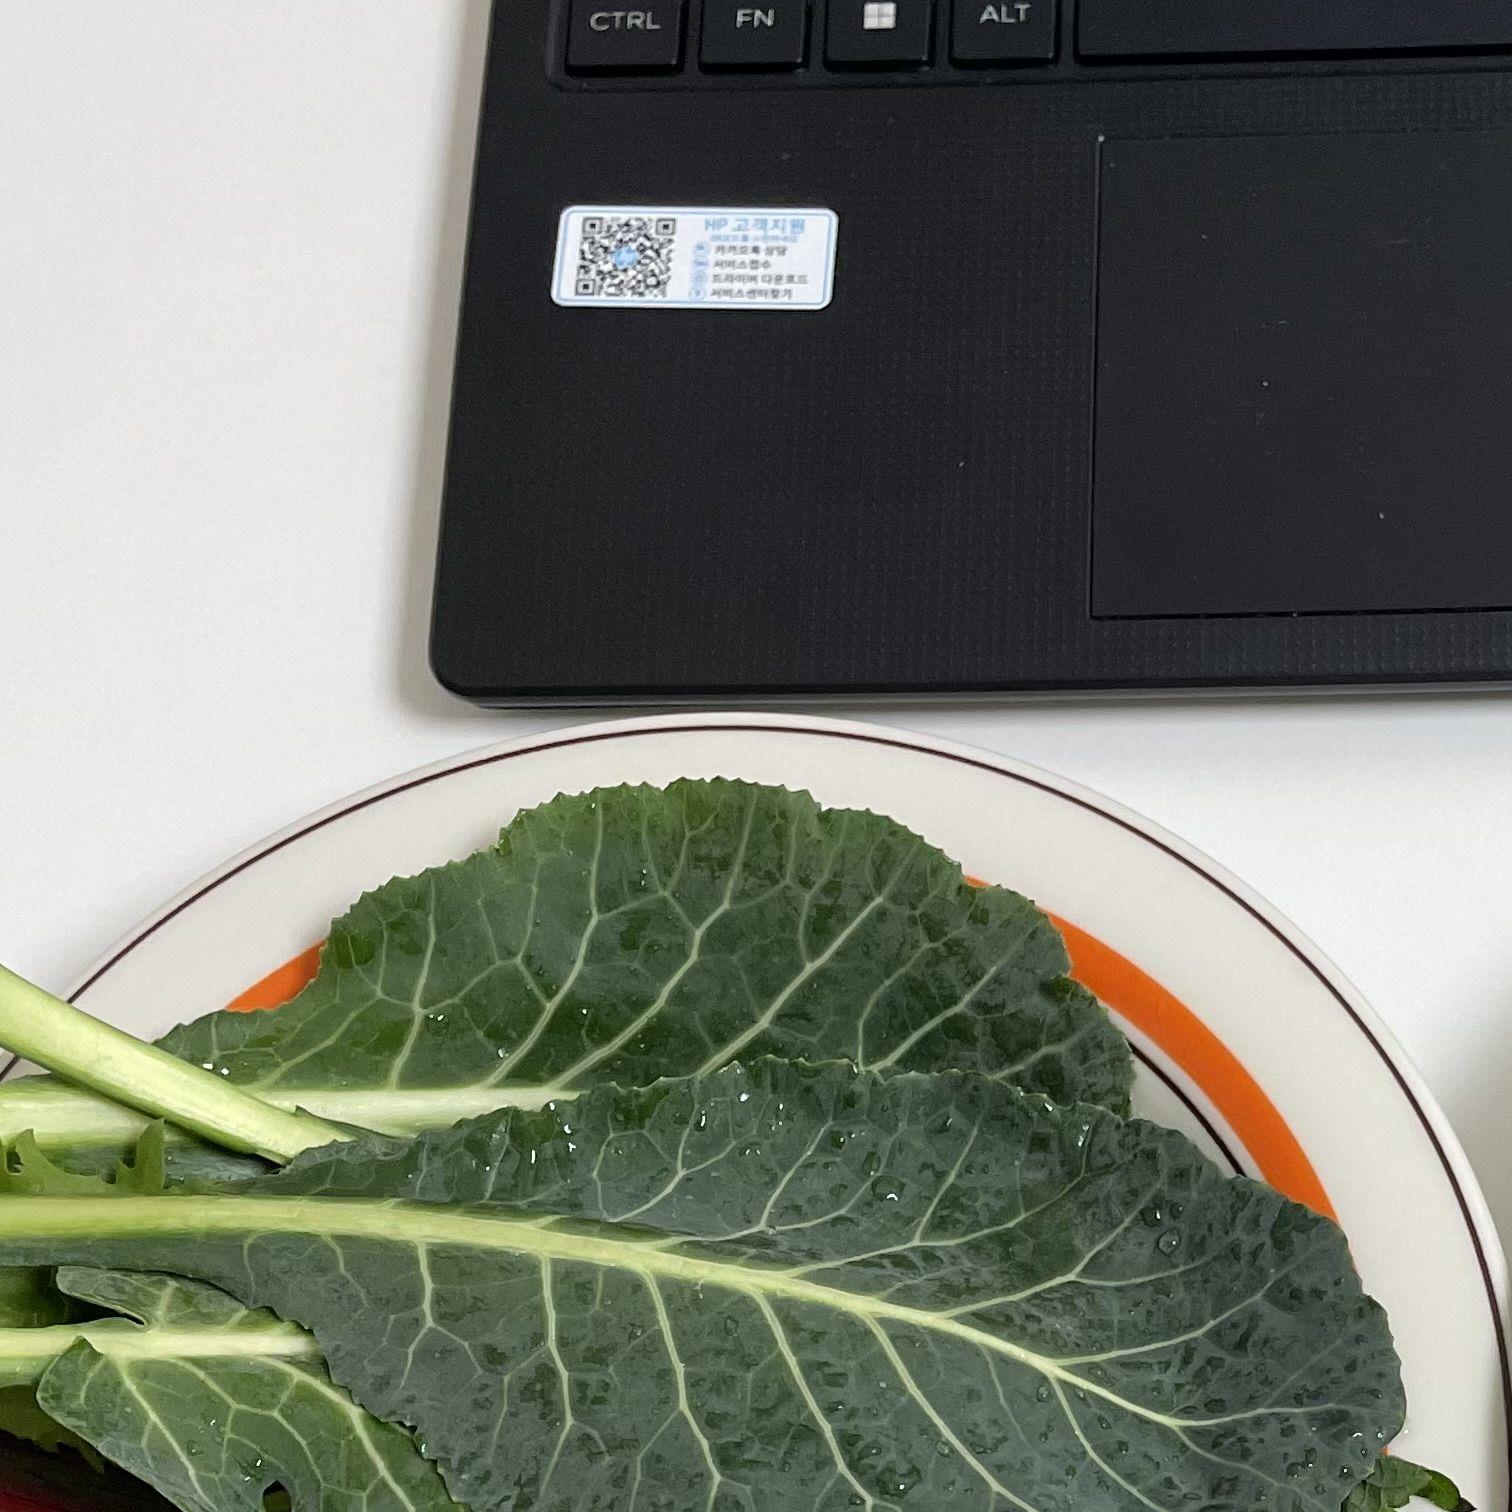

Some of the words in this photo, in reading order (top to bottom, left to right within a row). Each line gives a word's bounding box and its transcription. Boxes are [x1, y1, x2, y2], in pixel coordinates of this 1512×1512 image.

[589, 10, 661, 31] CTRL
[735, 8, 775, 28] FN
[979, 4, 1033, 25] ALT
[704, 218, 728, 231] HP
[731, 217, 806, 234] 고객지원
